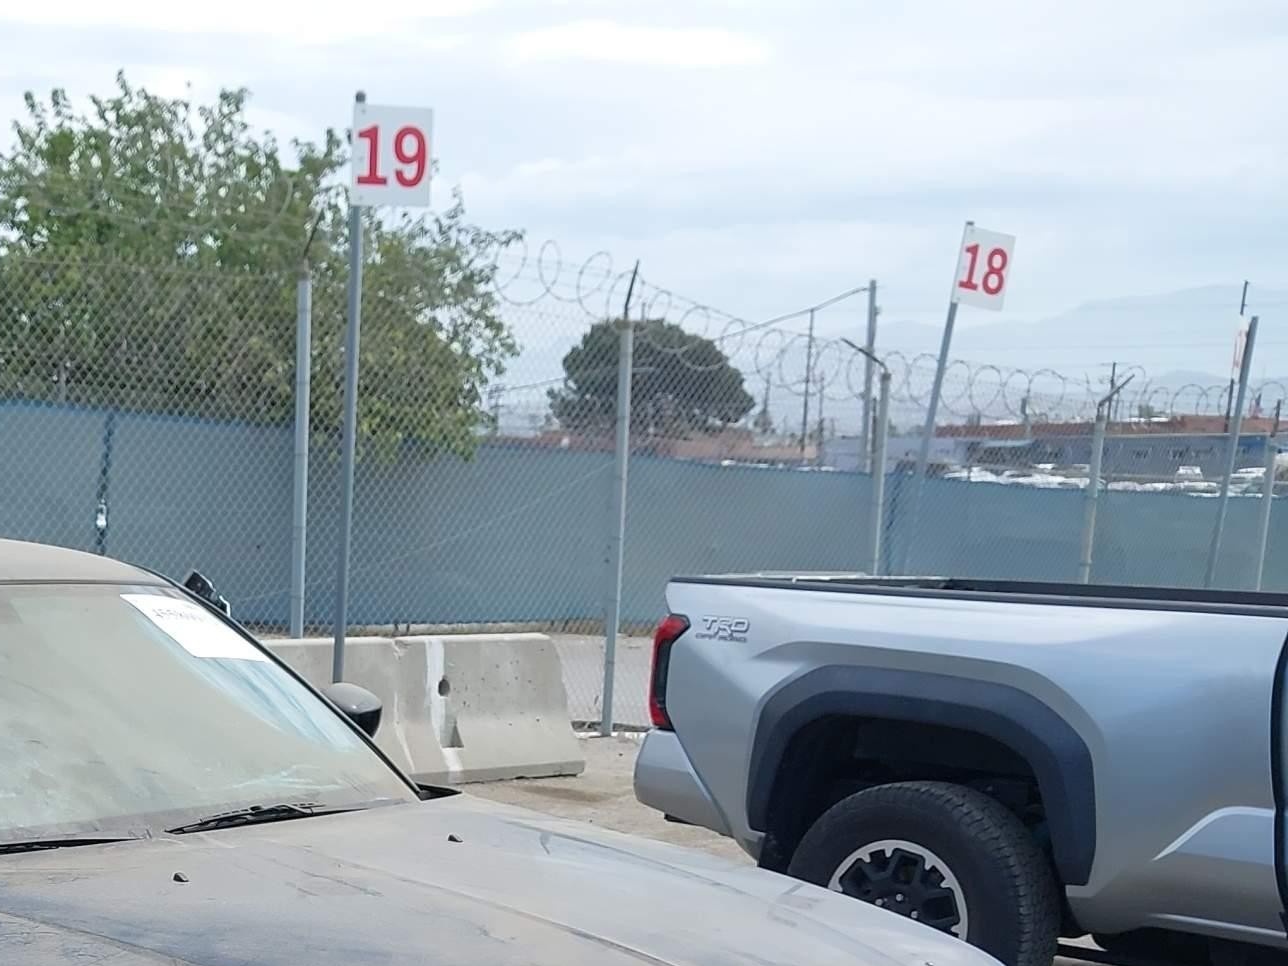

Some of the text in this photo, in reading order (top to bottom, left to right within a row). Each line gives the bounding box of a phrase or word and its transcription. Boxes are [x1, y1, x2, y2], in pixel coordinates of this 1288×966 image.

[357, 125, 426, 187] 19
[958, 244, 1008, 295] 18
[702, 615, 750, 636] TRD
